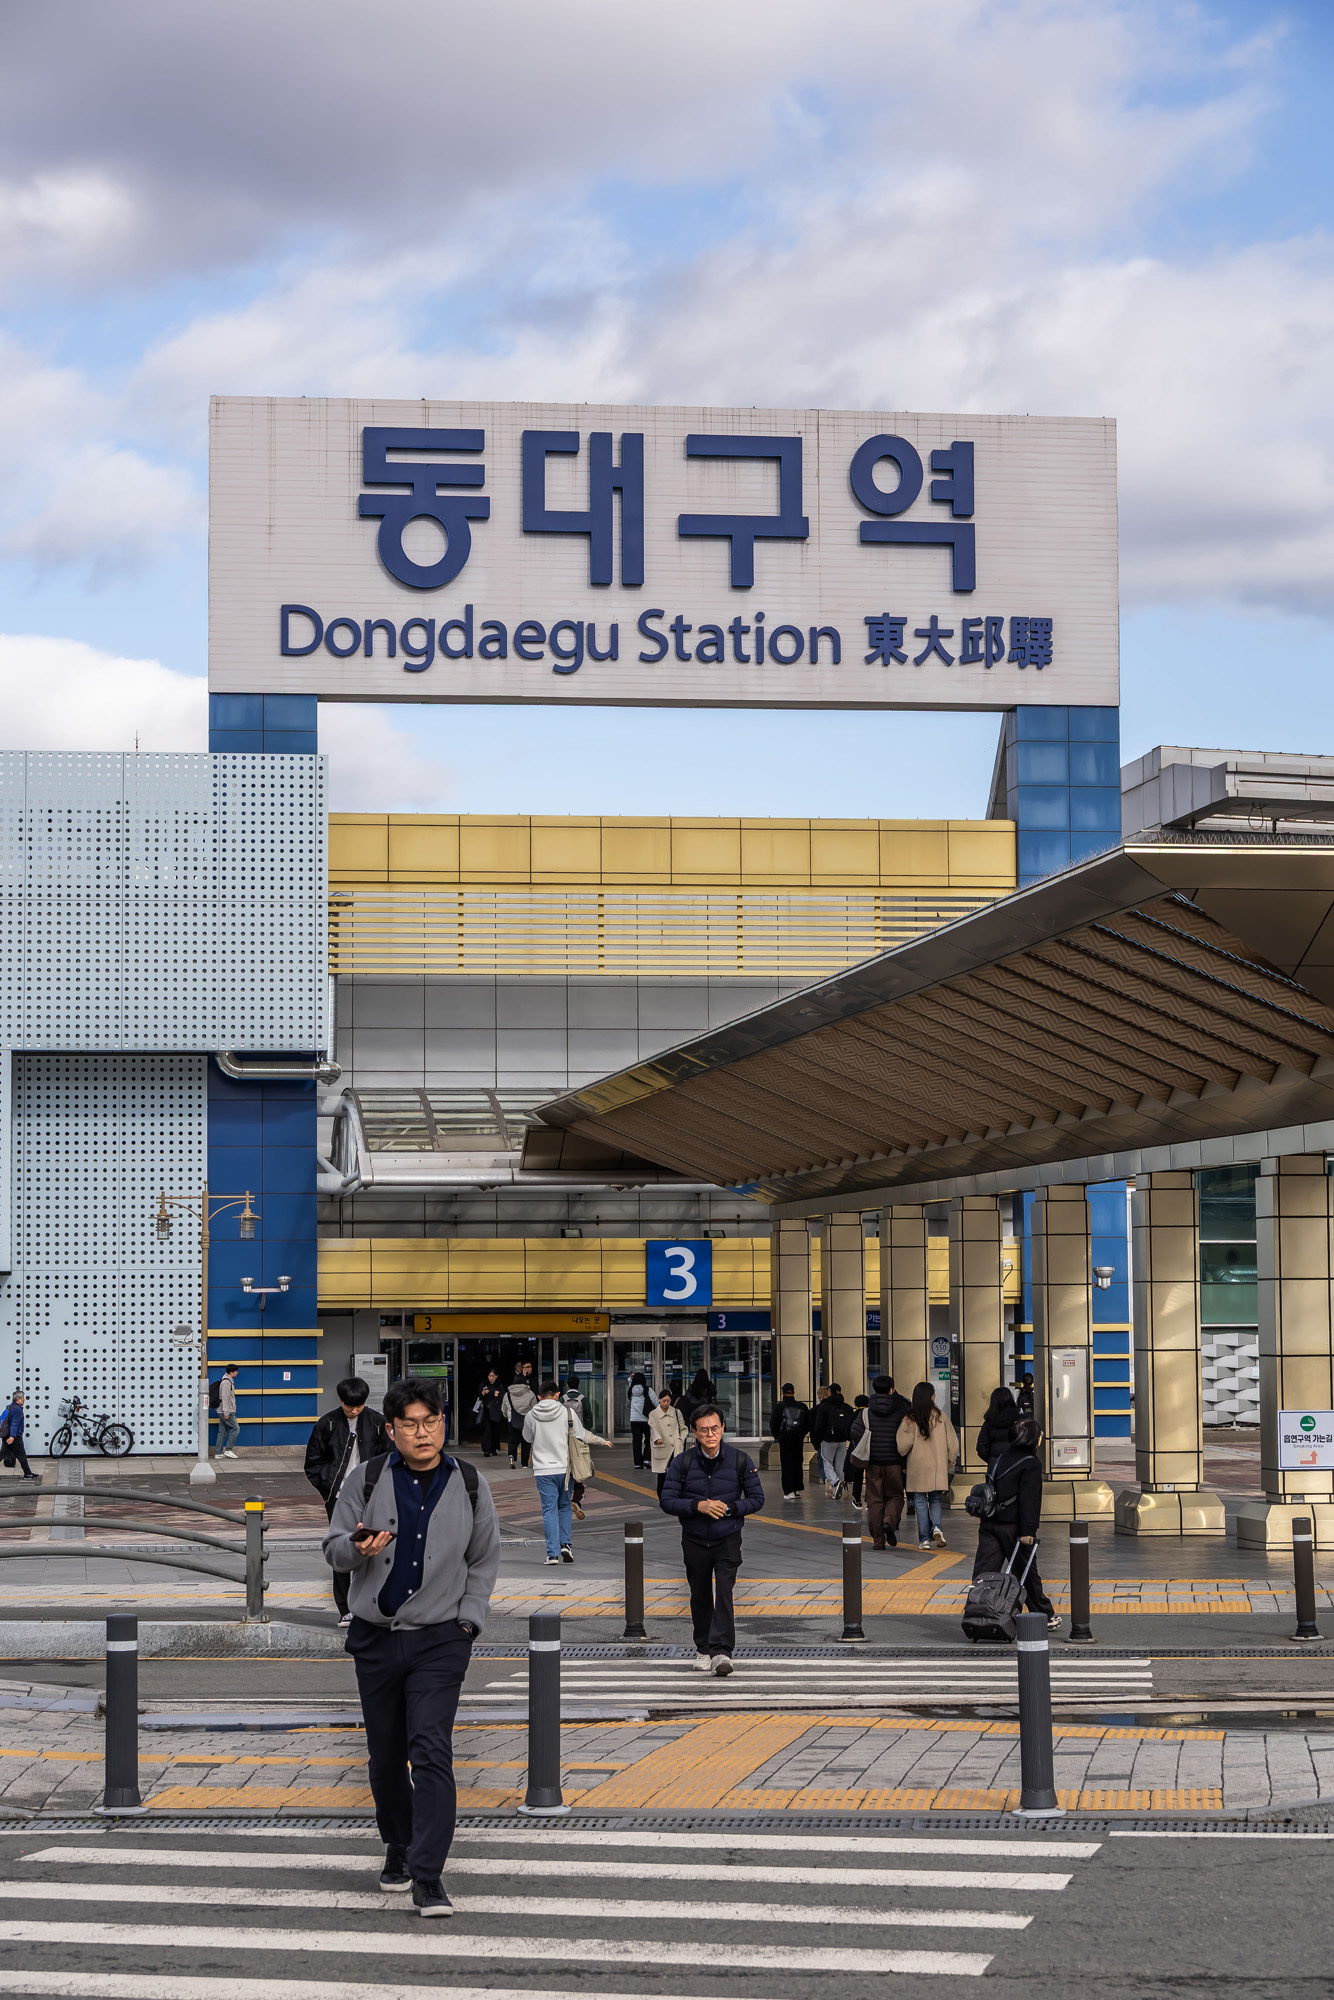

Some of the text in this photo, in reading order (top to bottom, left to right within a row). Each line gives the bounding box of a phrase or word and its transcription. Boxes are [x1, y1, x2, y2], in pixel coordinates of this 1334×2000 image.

[359, 426, 978, 594] 동대구역
[279, 604, 843, 675] Dongdaegu Station
[864, 612, 1055, 670] 東大邱驛
[662, 1246, 698, 1301] 3
[424, 1316, 433, 1331] 3
[717, 1313, 727, 1329] 3
[1284, 1435, 1333, 1443] 흡연구역 가는길
